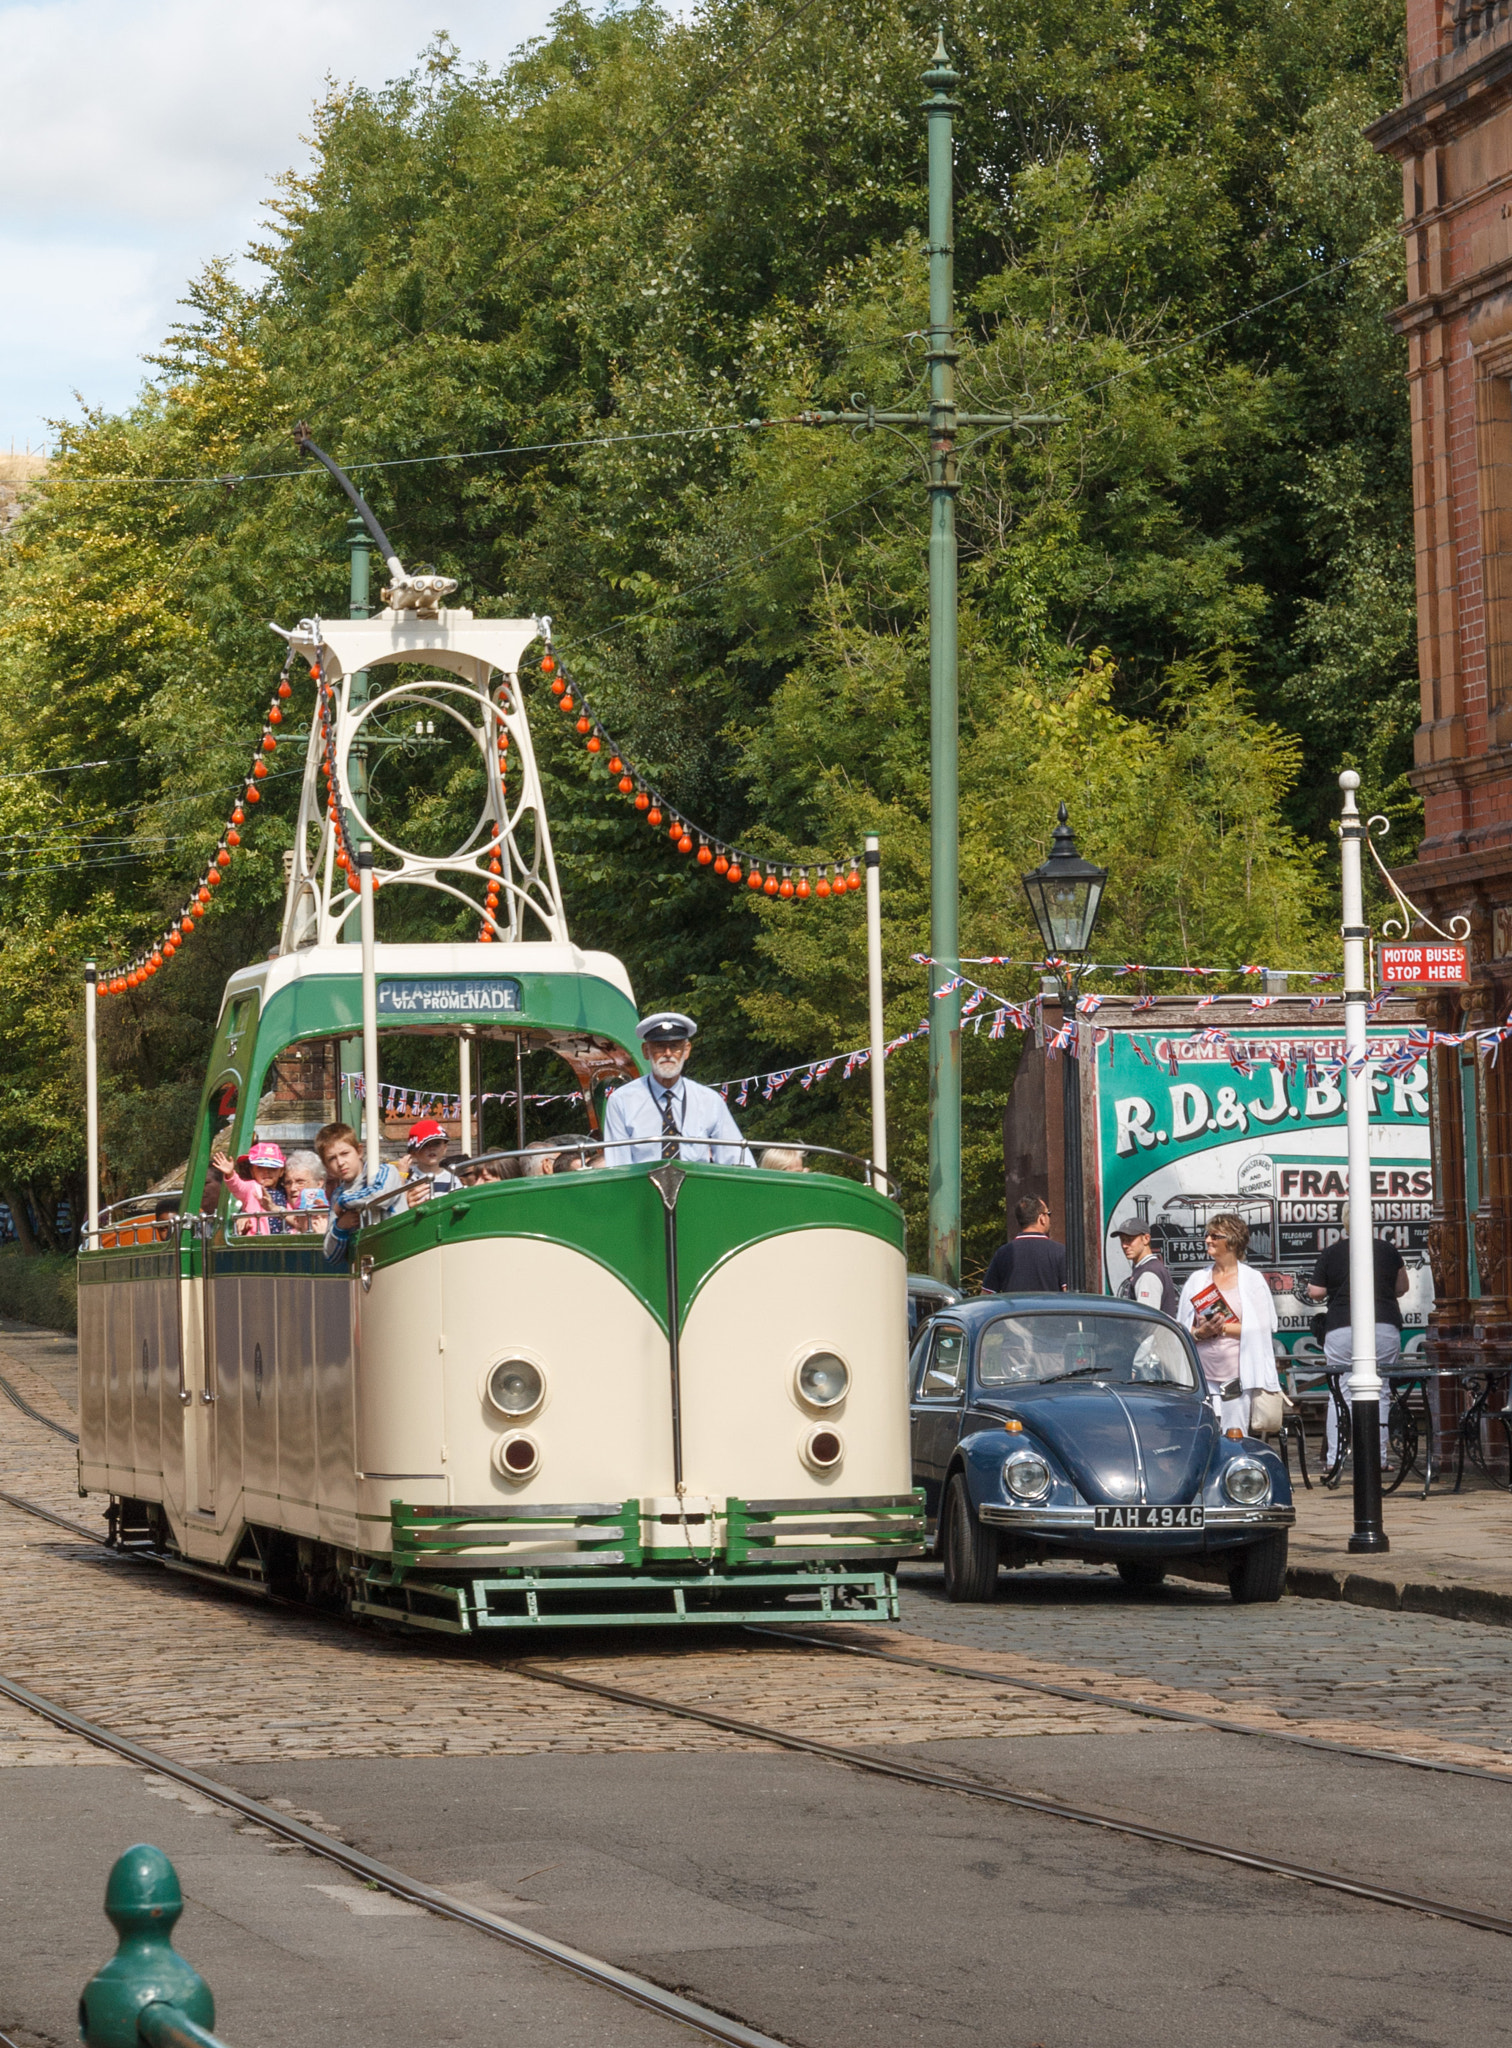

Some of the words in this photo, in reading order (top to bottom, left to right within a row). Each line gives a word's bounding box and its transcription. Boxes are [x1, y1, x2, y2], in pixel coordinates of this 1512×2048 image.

[1385, 949, 1422, 962] MOTOR
[1426, 948, 1464, 962] BUSES
[1387, 966, 1421, 979] STOP
[1428, 965, 1462, 978] HERE
[379, 983, 459, 1003] PLEASURE
[393, 1001, 416, 1010] VIA
[423, 990, 515, 1010] PROMENADE
[1281, 1170, 1431, 1197] FRAERS
[1281, 1202, 1338, 1222] HOUSE
[1281, 1231, 1313, 1239] TELEGRAMS
[1097, 1508, 1140, 1527] TAH
[1146, 1507, 1203, 1527] 494G
